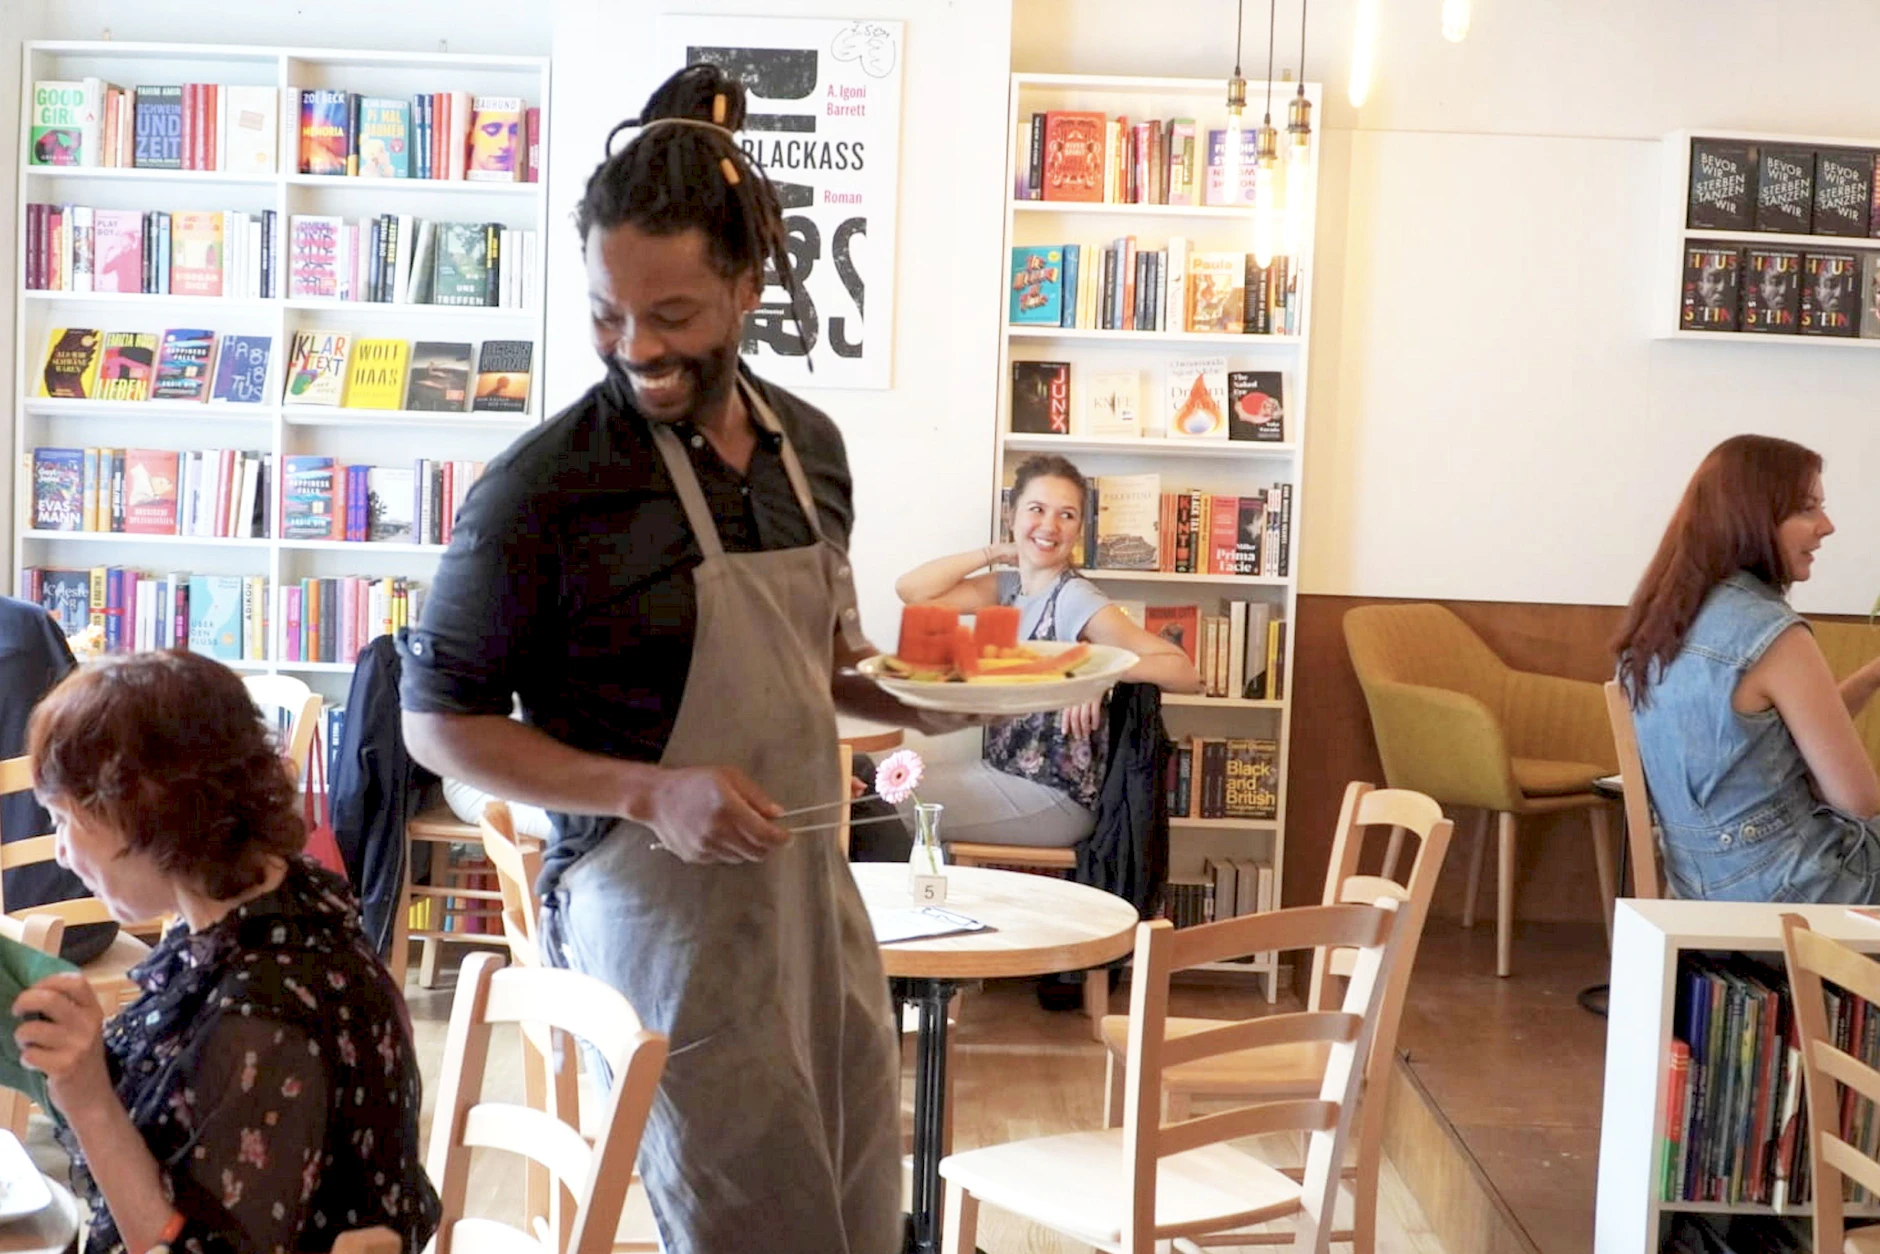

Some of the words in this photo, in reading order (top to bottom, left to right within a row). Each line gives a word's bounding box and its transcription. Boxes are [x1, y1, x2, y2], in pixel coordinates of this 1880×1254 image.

[37, 88, 84, 106] GOOD
[827, 84, 838, 98] A.
[839, 85, 866, 99] Igoni
[827, 102, 866, 116] Barrett
[137, 114, 180, 136] UND
[136, 136, 181, 158] ZEIT
[742, 139, 865, 171] BLACKASS
[1701, 152, 1737, 173] BEVOR
[1767, 157, 1802, 178] BEVOR
[1702, 164, 1724, 178] WIR
[1768, 168, 1788, 182] WIR
[1823, 161, 1859, 181] BEVOR
[1824, 172, 1845, 186] WIR
[1697, 174, 1745, 192] STERBEN
[1762, 177, 1810, 197] STERBEN
[1819, 181, 1867, 200] STERBEN
[824, 190, 863, 205] Roman
[1698, 184, 1744, 203] TANZEN
[1764, 189, 1809, 206] TANZEN
[1821, 193, 1867, 210] TANZEN
[1716, 200, 1737, 214] WIR
[1781, 204, 1802, 217] WIR
[1838, 207, 1859, 221] WIR
[295, 334, 346, 362] KLAR
[355, 367, 398, 386] HAAS
[38, 500, 71, 512] EVAS
[38, 511, 81, 524] MANN
[1216, 549, 1255, 562] Prima
[1226, 760, 1271, 775] Black
[1227, 776, 1256, 790] and
[1226, 789, 1275, 805] British
[924, 885, 935, 899] 5
